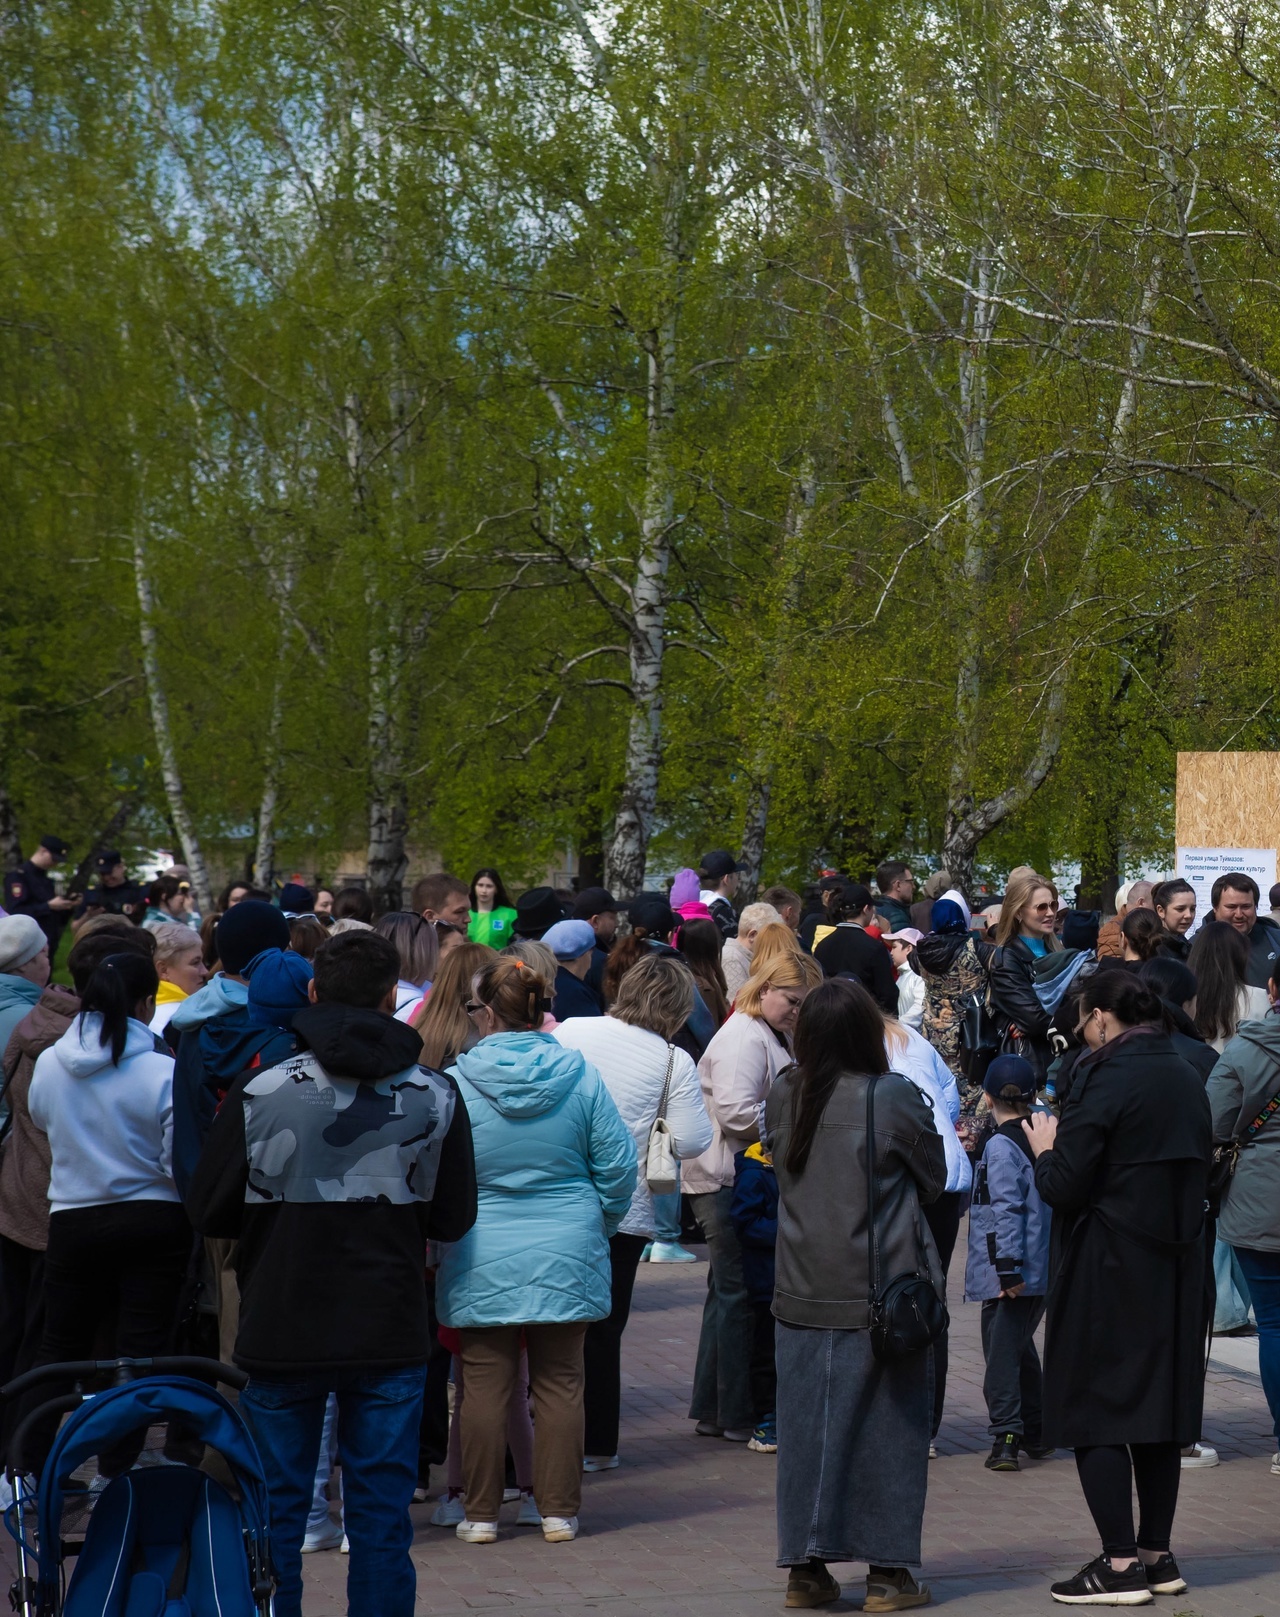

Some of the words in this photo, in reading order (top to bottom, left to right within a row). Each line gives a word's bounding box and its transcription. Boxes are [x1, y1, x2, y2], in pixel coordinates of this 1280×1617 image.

[1185, 854, 1204, 862] Первая
[1220, 855, 1244, 863] Туймазов:
[1184, 864, 1219, 872] переплетение
